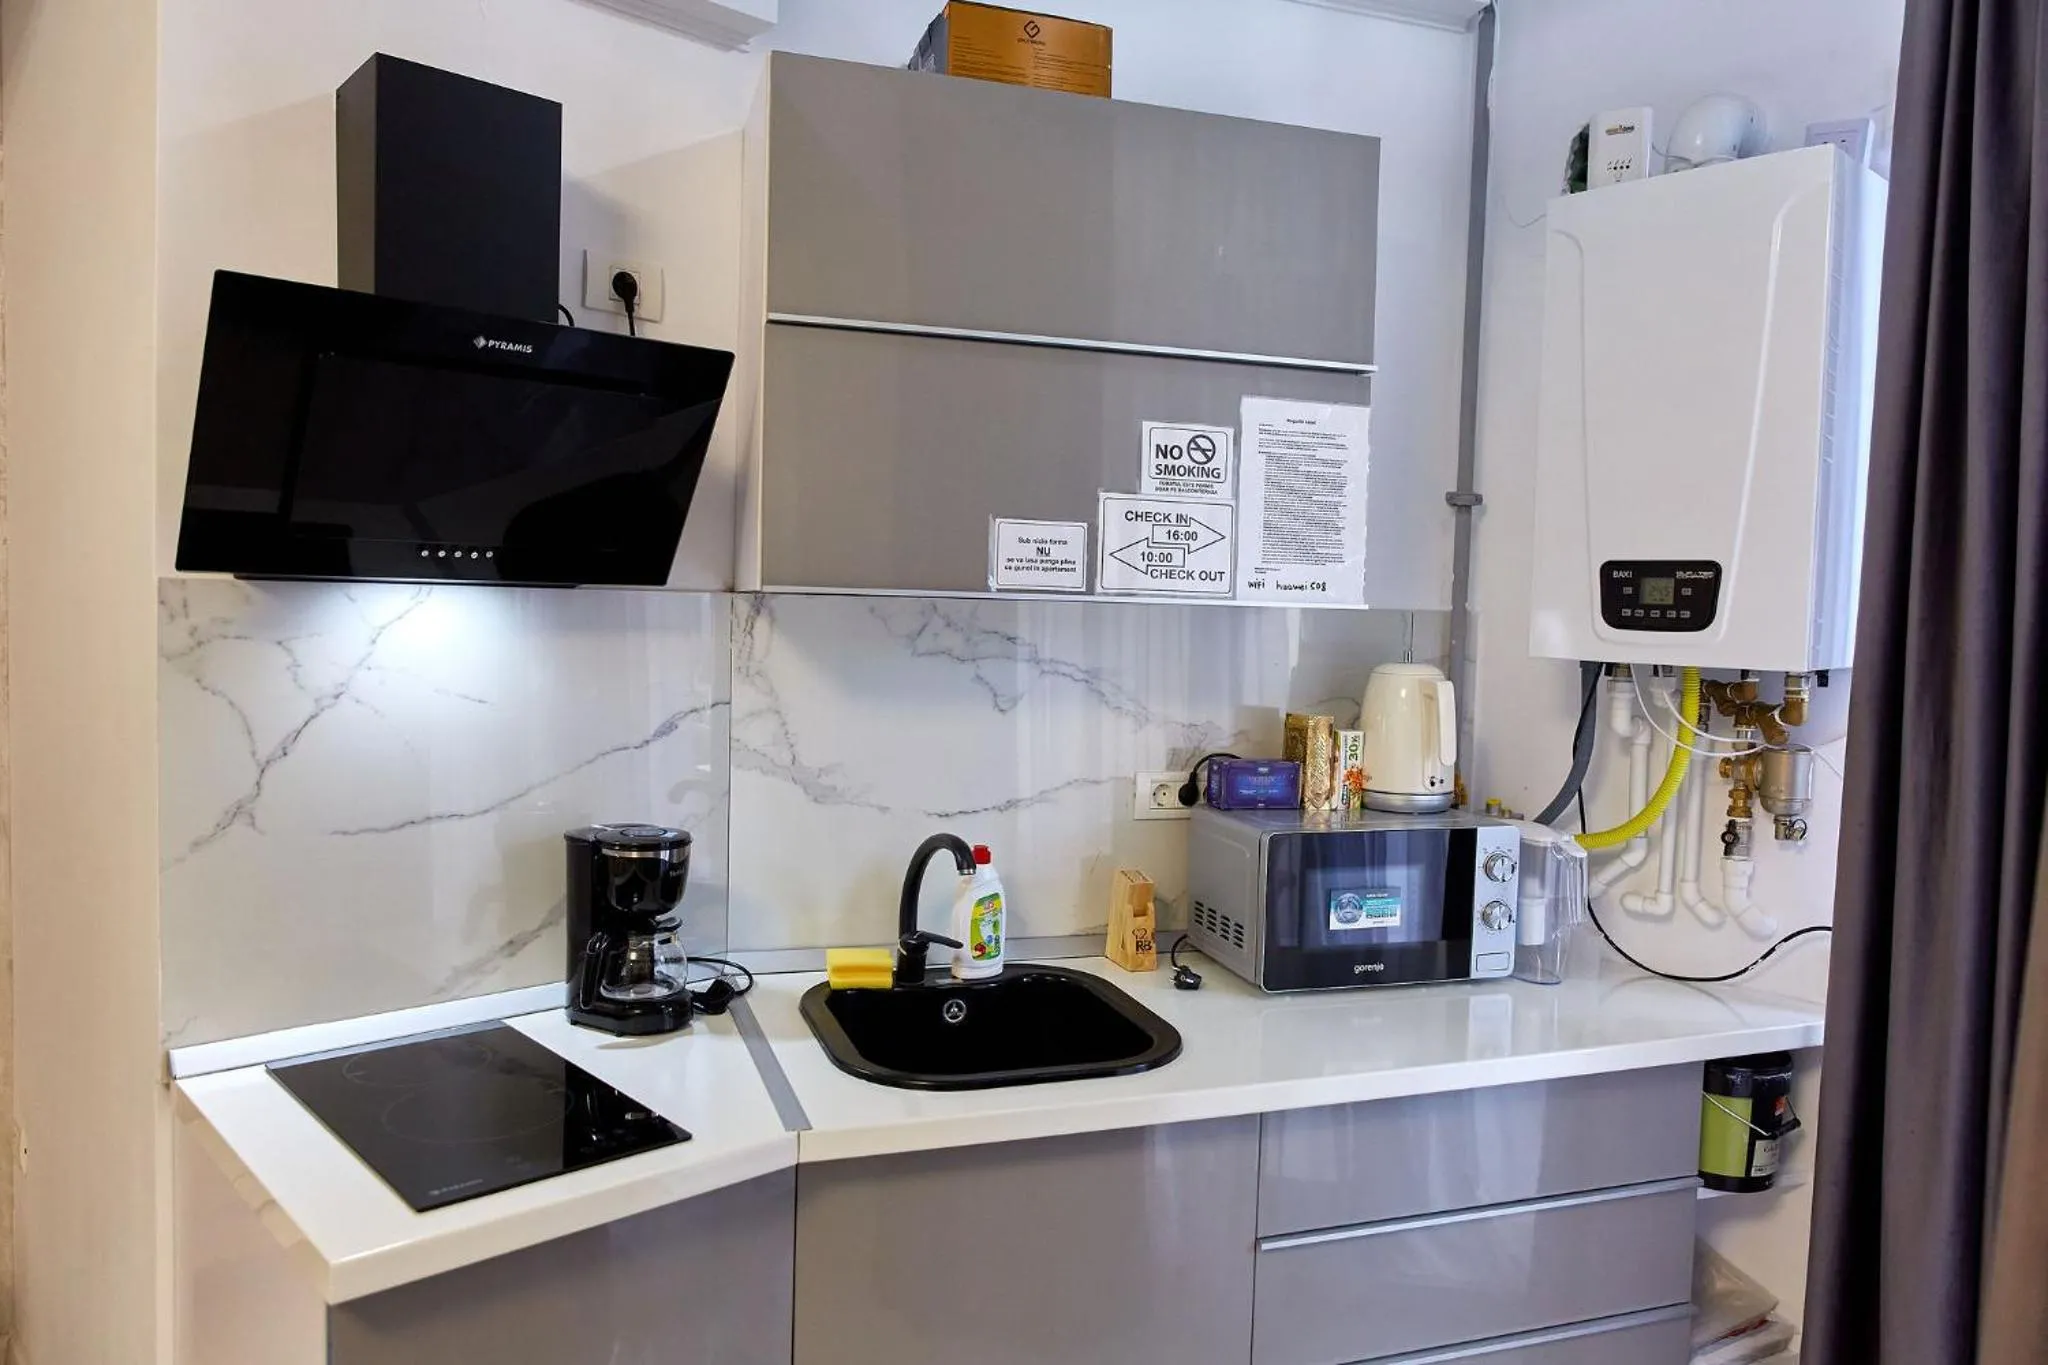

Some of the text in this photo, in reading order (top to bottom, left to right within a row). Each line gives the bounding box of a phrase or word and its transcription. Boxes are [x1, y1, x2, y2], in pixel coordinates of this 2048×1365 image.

[488, 339, 533, 353] PYRAMIS
[1155, 444, 1183, 460] NO
[1155, 463, 1221, 479] SMOKING
[1125, 510, 1189, 524] CHECK IN
[1166, 529, 1198, 541] 16:00
[1036, 546, 1051, 556] NU
[1140, 551, 1173, 563] 10:00
[1150, 568, 1226, 582] CHECK OUT
[1612, 570, 1633, 578] BAXI
[1353, 962, 1384, 975] gorenje
